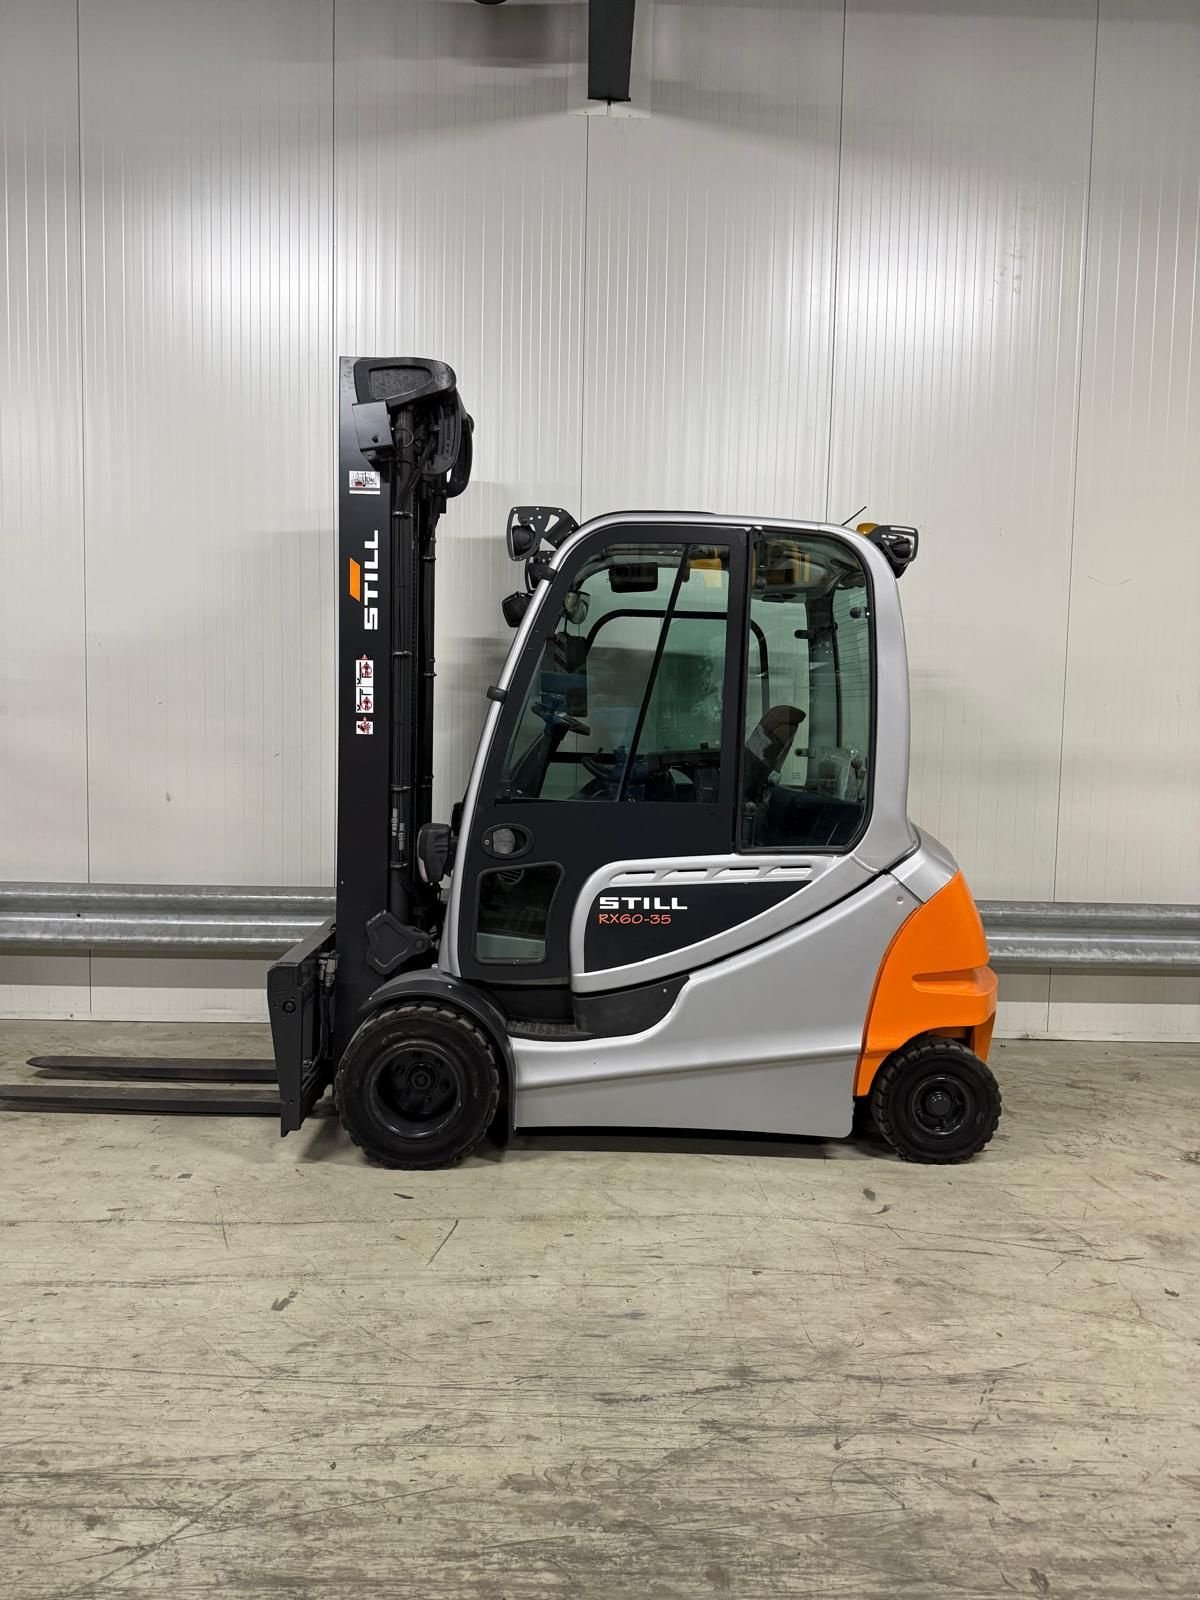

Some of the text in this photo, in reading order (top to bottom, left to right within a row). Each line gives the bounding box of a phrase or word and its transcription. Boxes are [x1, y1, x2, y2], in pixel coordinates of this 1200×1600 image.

[364, 530, 378, 630] STILL
[599, 896, 688, 910] STILL
[598, 913, 672, 925] RX60-35
